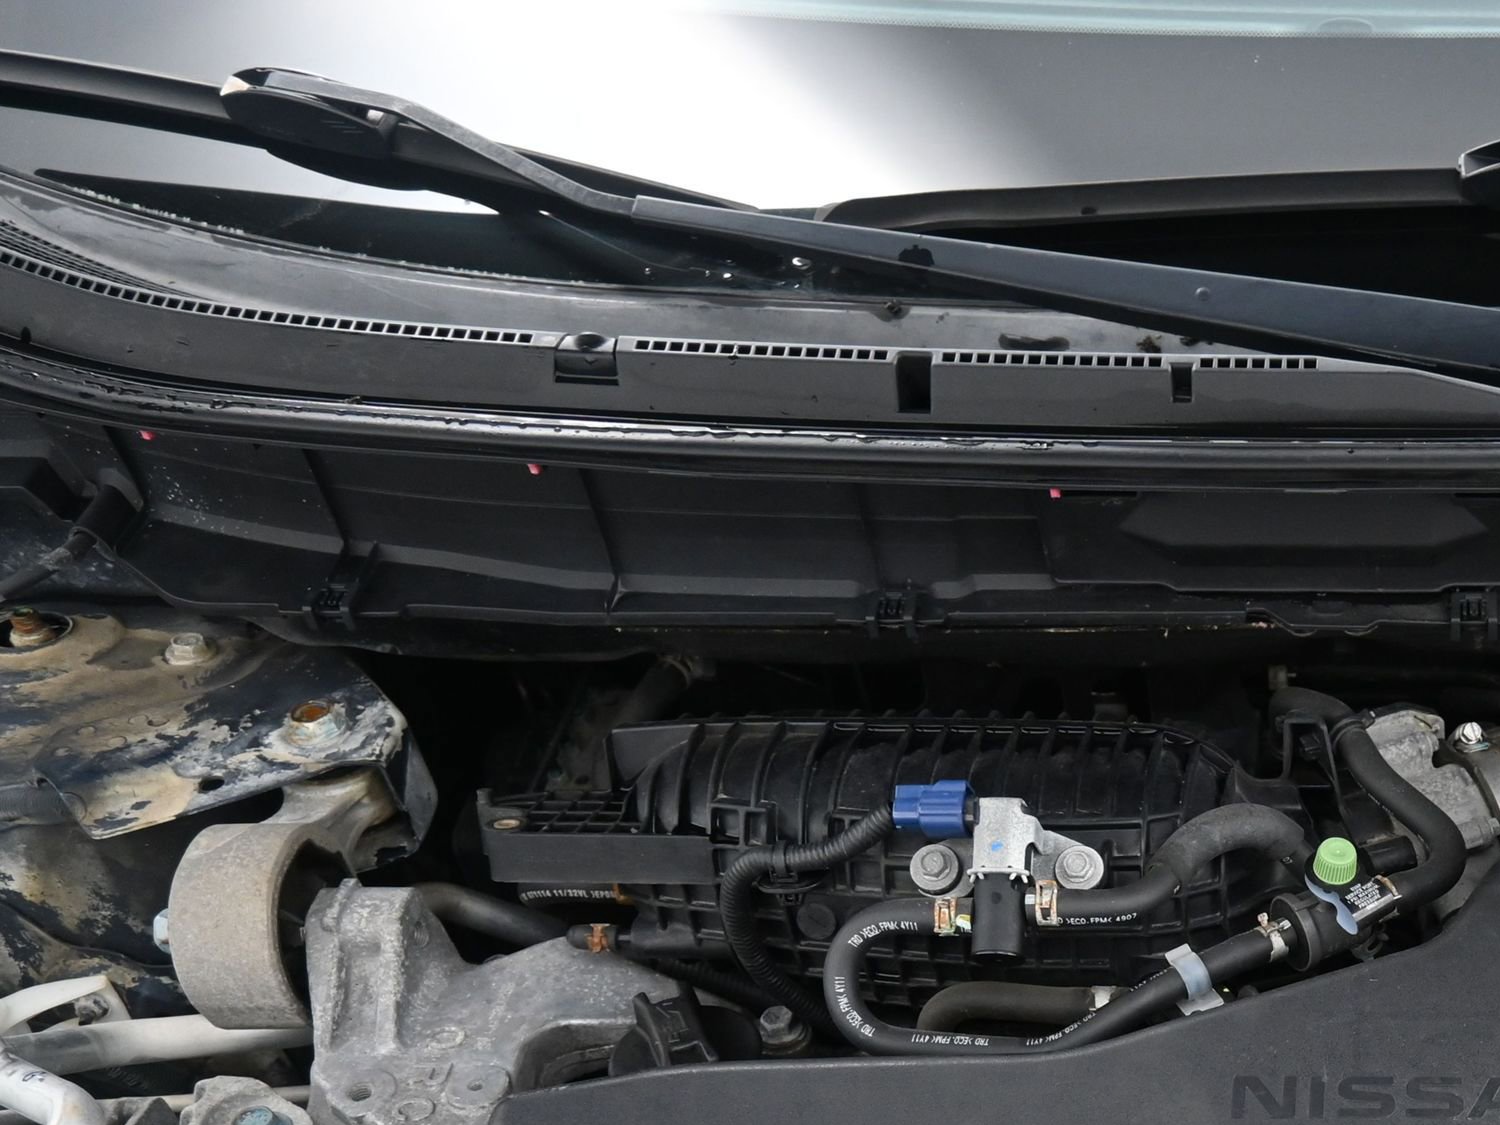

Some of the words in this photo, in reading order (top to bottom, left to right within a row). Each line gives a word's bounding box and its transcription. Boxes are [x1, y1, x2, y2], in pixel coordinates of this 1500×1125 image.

[848, 934, 863, 948] TRD
[900, 921, 918, 931] 4Y11
[834, 976, 846, 992] 4Y11
[861, 1023, 876, 1037] TRD
[911, 1034, 929, 1043] 4Y11
[974, 1037, 990, 1046] TRD
[1026, 1036, 1043, 1046] 4Y11
